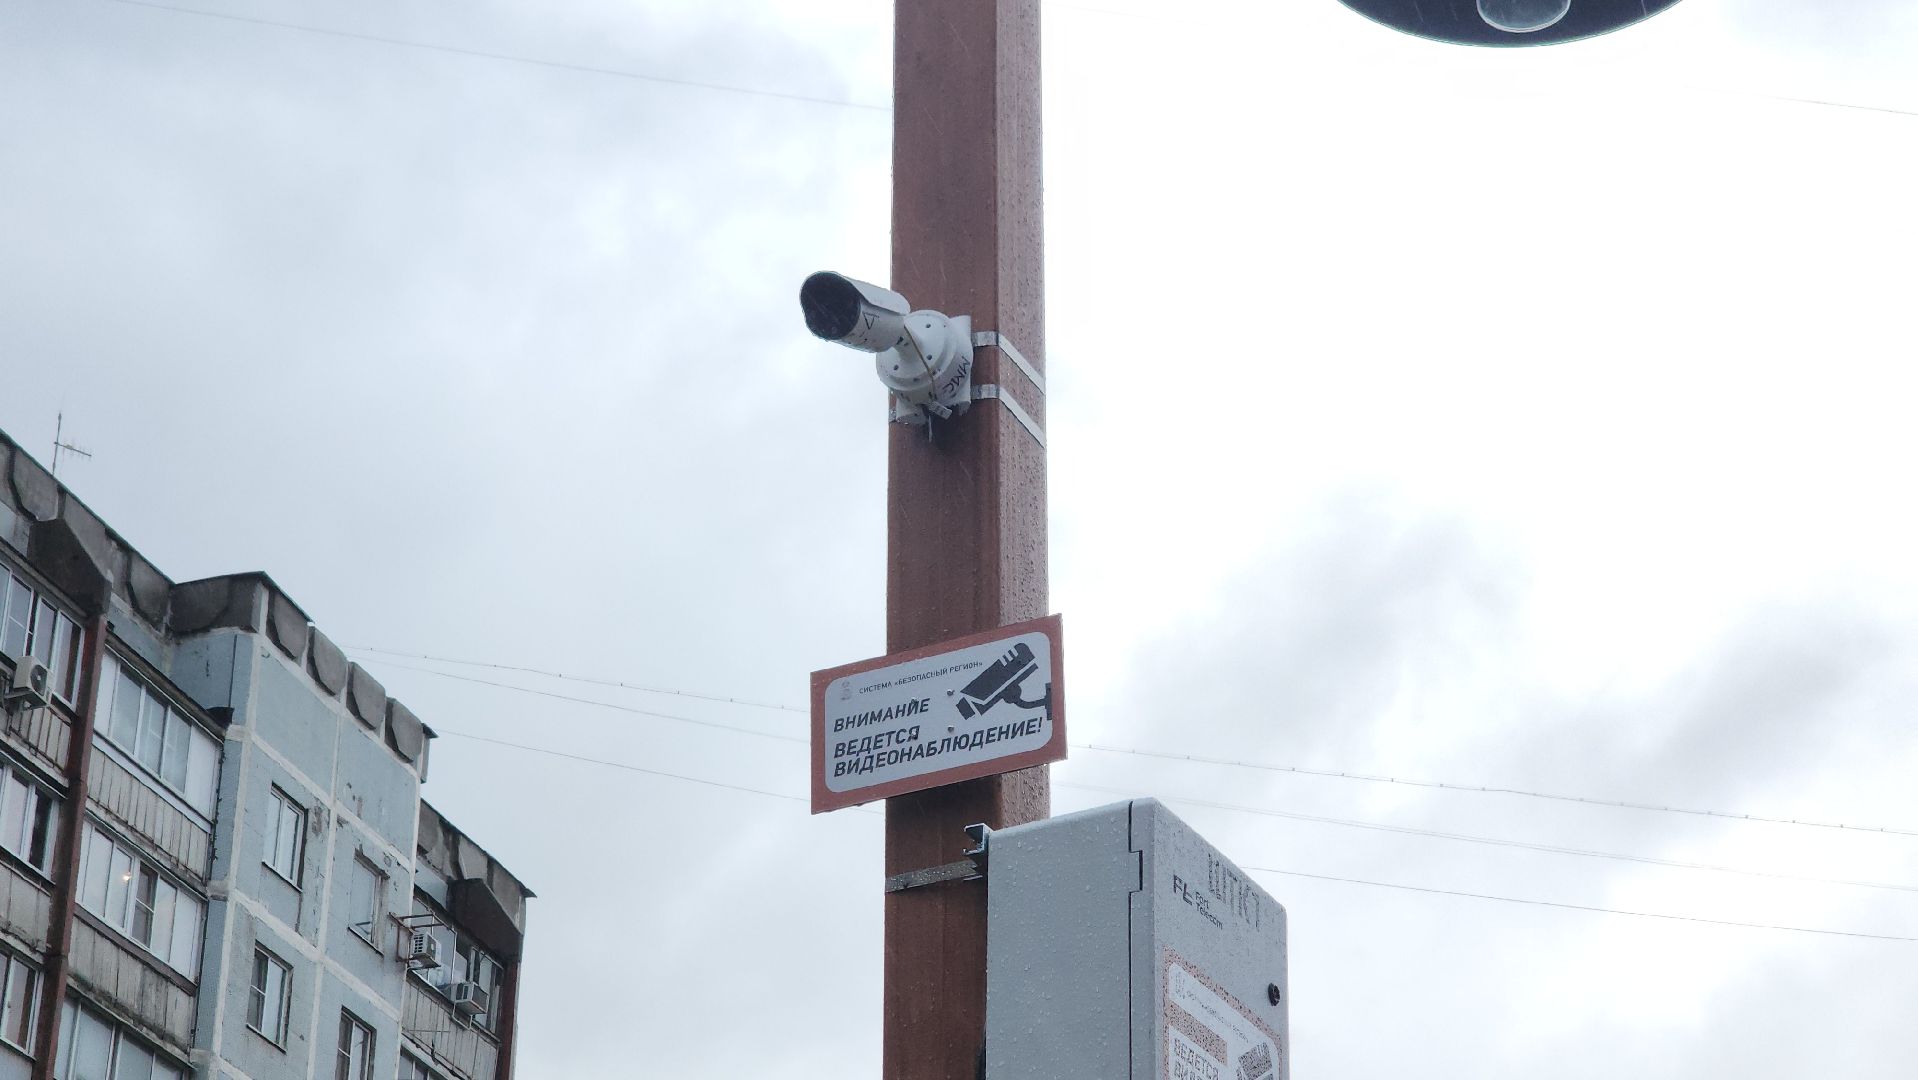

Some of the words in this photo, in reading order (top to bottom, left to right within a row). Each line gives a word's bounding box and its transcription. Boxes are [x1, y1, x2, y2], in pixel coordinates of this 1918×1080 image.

[859, 681, 893, 694] СИСТЕМА
[949, 661, 983, 675] РЕГИОН»
[833, 697, 931, 733] ВНИМАНИЕ
[833, 725, 921, 759] ВЕДЕТСЯ
[833, 716, 1043, 778] ВИДЕОНАБЛЮДЕНИЕ!
